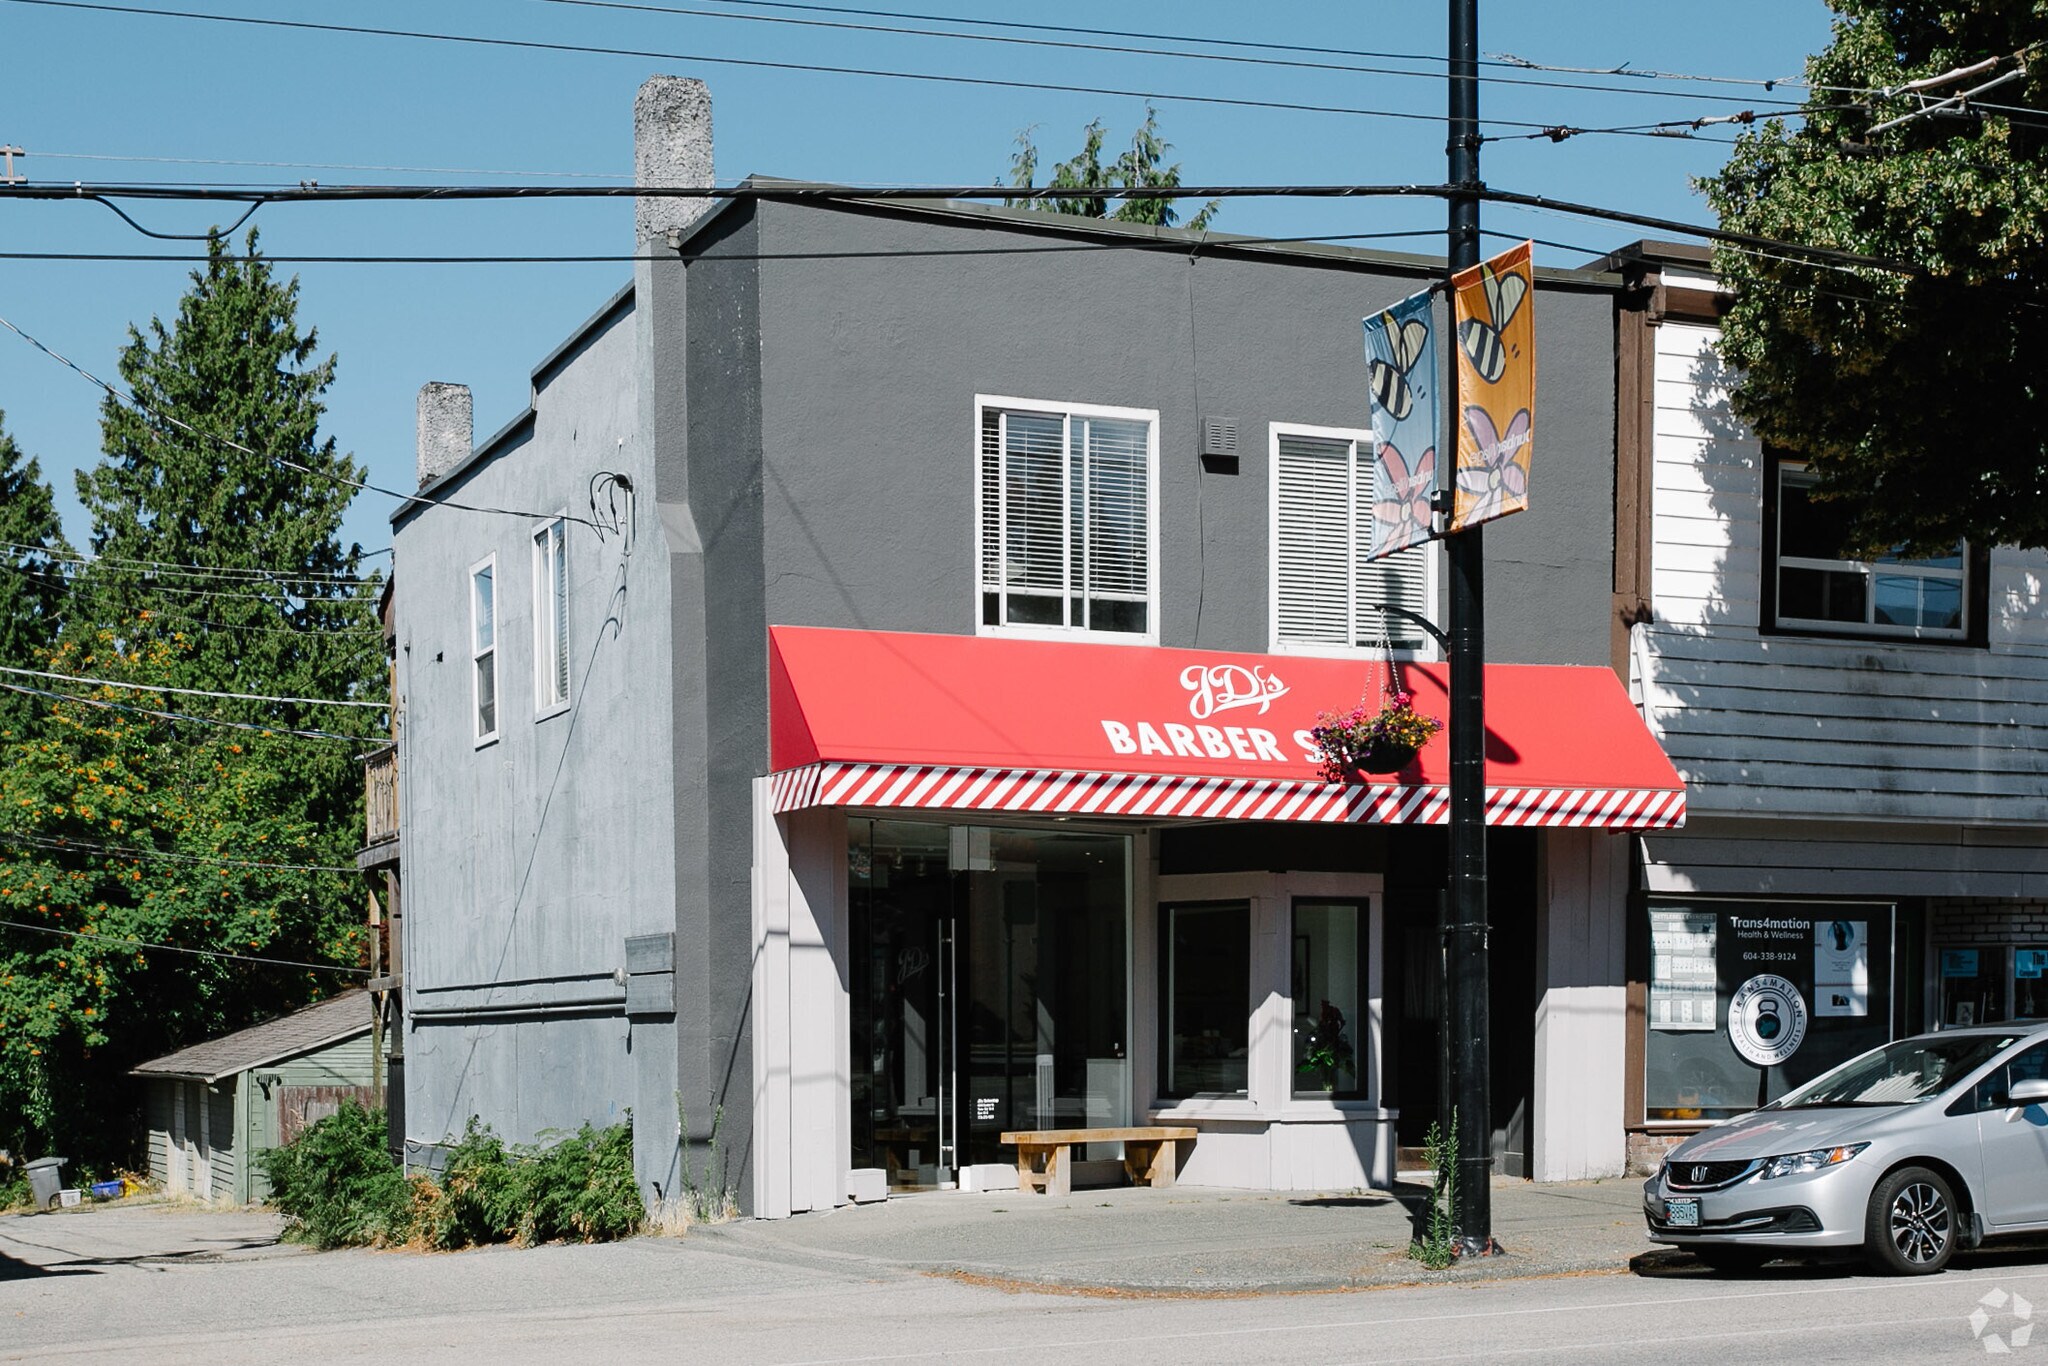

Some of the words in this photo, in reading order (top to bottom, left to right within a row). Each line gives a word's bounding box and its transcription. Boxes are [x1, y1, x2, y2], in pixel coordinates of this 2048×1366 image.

[1101, 720, 1288, 762] BARBER
[1730, 916, 1810, 930] Trans4mation
[1737, 930, 1762, 938] Health
[1763, 931, 1769, 939] &
[1771, 931, 1803, 939] Wellness
[1743, 951, 1796, 960] 604-338-9124
[1734, 979, 1803, 1018] TRANS4MATION
[1734, 1029, 1755, 1055] HEALTH
[1756, 1052, 1772, 1060] AND
[1774, 1029, 1801, 1058] WELLNESS
